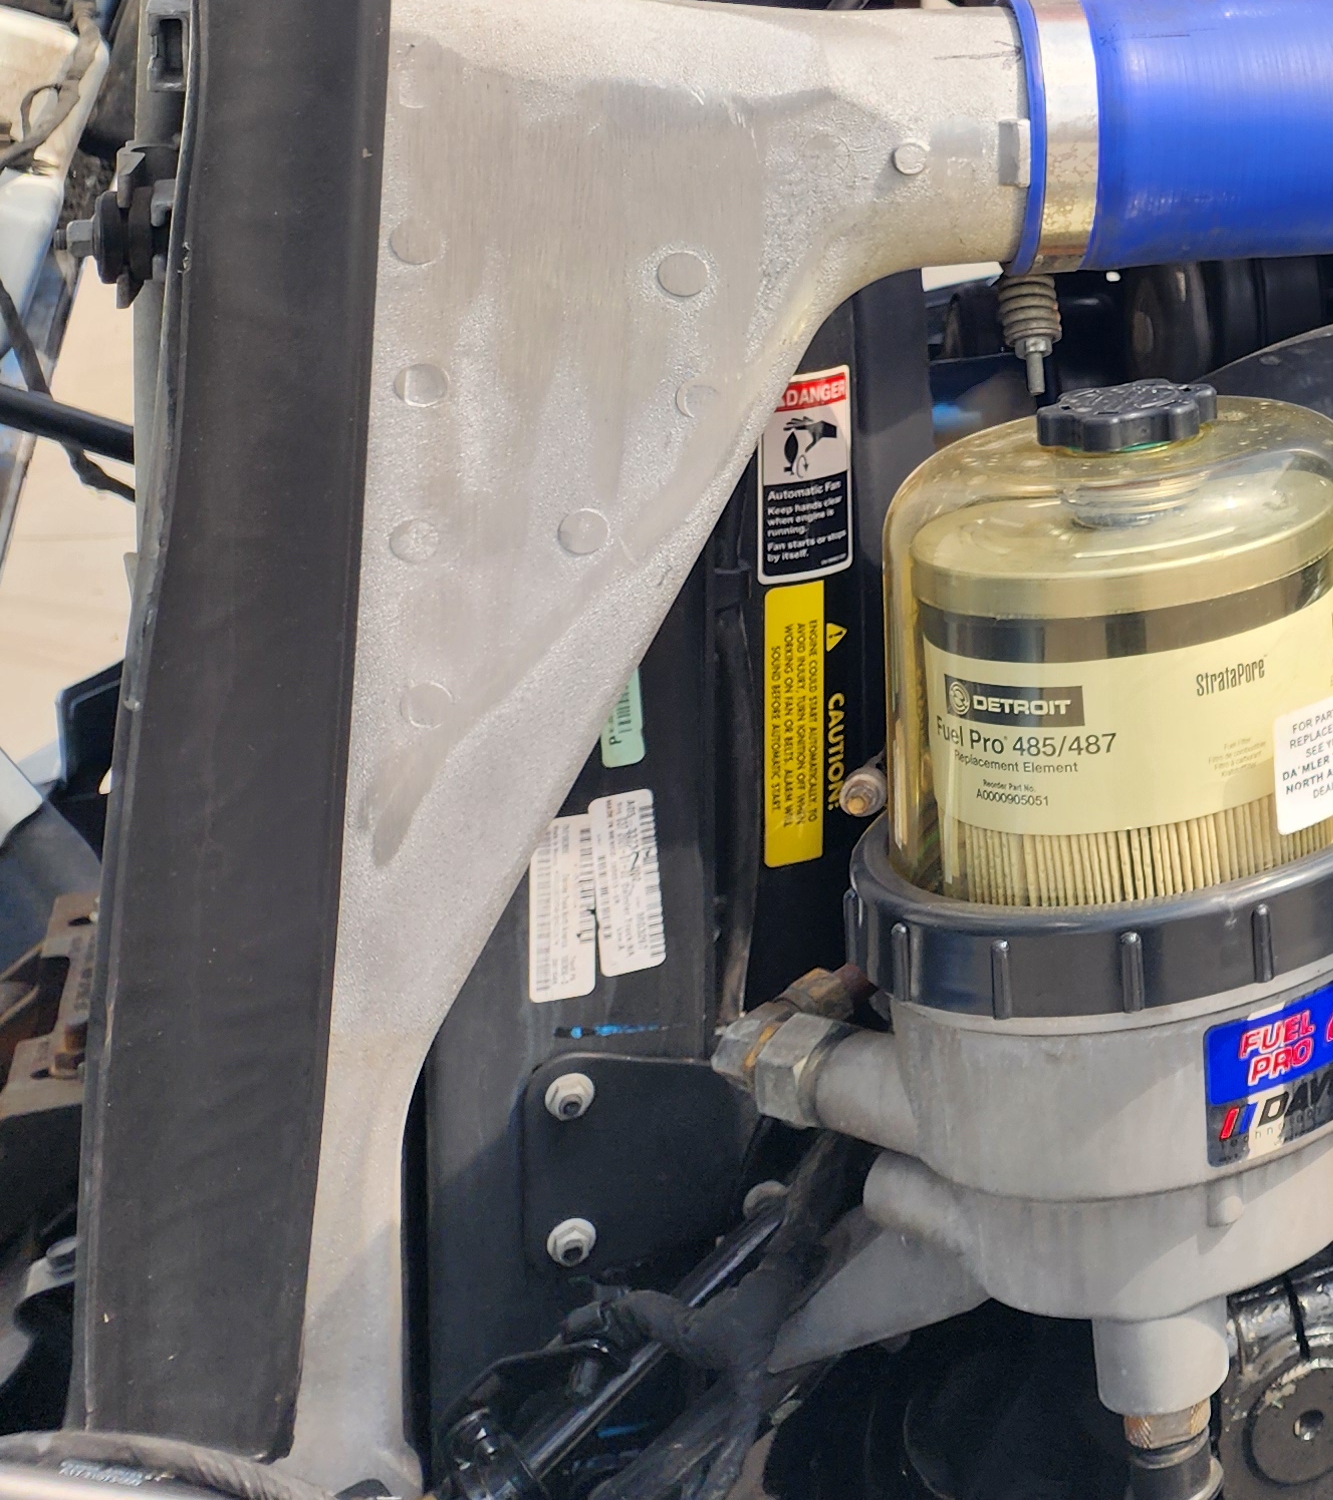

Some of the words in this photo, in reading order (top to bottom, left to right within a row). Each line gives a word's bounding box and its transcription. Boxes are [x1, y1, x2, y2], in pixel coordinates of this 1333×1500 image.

[786, 380, 847, 408] DANGER
[767, 484, 824, 502] Automatic
[824, 479, 842, 494] Fan
[767, 503, 792, 517] Keep
[793, 499, 823, 514] hands
[767, 513, 794, 527] when
[795, 511, 826, 525] engine
[826, 508, 835, 520] is
[767, 525, 808, 537] running.
[767, 541, 786, 552] Fan
[787, 536, 816, 549] starts
[817, 534, 827, 545] or
[767, 552, 781, 564] by
[781, 549, 810, 562] itself.
[784, 623, 794, 674] WORKING
[796, 623, 806, 653] AVOID
[808, 620, 818, 657] ENGINE
[771, 646, 781, 682] SOUND
[784, 677, 794, 693] ON
[808, 660, 818, 693] COULD
[1196, 657, 1266, 697] StrataPore
[771, 684, 781, 720] BEFORE
[784, 696, 794, 717] FAN
[796, 696, 806, 722] TURN
[808, 696, 818, 722] START
[972, 695, 1072, 716] DETROIT
[784, 719, 794, 734] OR
[937, 716, 964, 747] Fuel
[1013, 732, 1117, 758] 485/487
[1292, 717, 1313, 734] FOR
[771, 724, 781, 780] AUTOMATIC
[796, 724, 806, 771] IGNITION
[828, 693, 845, 811] CAUTION:
[1305, 742, 1323, 758] SEE
[954, 750, 1020, 773] Replacement
[1023, 761, 1079, 774] Element
[784, 769, 793, 802] ALARM
[796, 773, 806, 790] OFF
[982, 779, 1007, 790] Reorder
[1008, 782, 1022, 791] Part
[1024, 784, 1036, 793] No.
[1285, 773, 1324, 795] NORTH
[976, 788, 1049, 807] A0000905051
[808, 808, 818, 823] TO
[1239, 1009, 1315, 1060] FUEL
[1248, 1037, 1314, 1087] PRO
